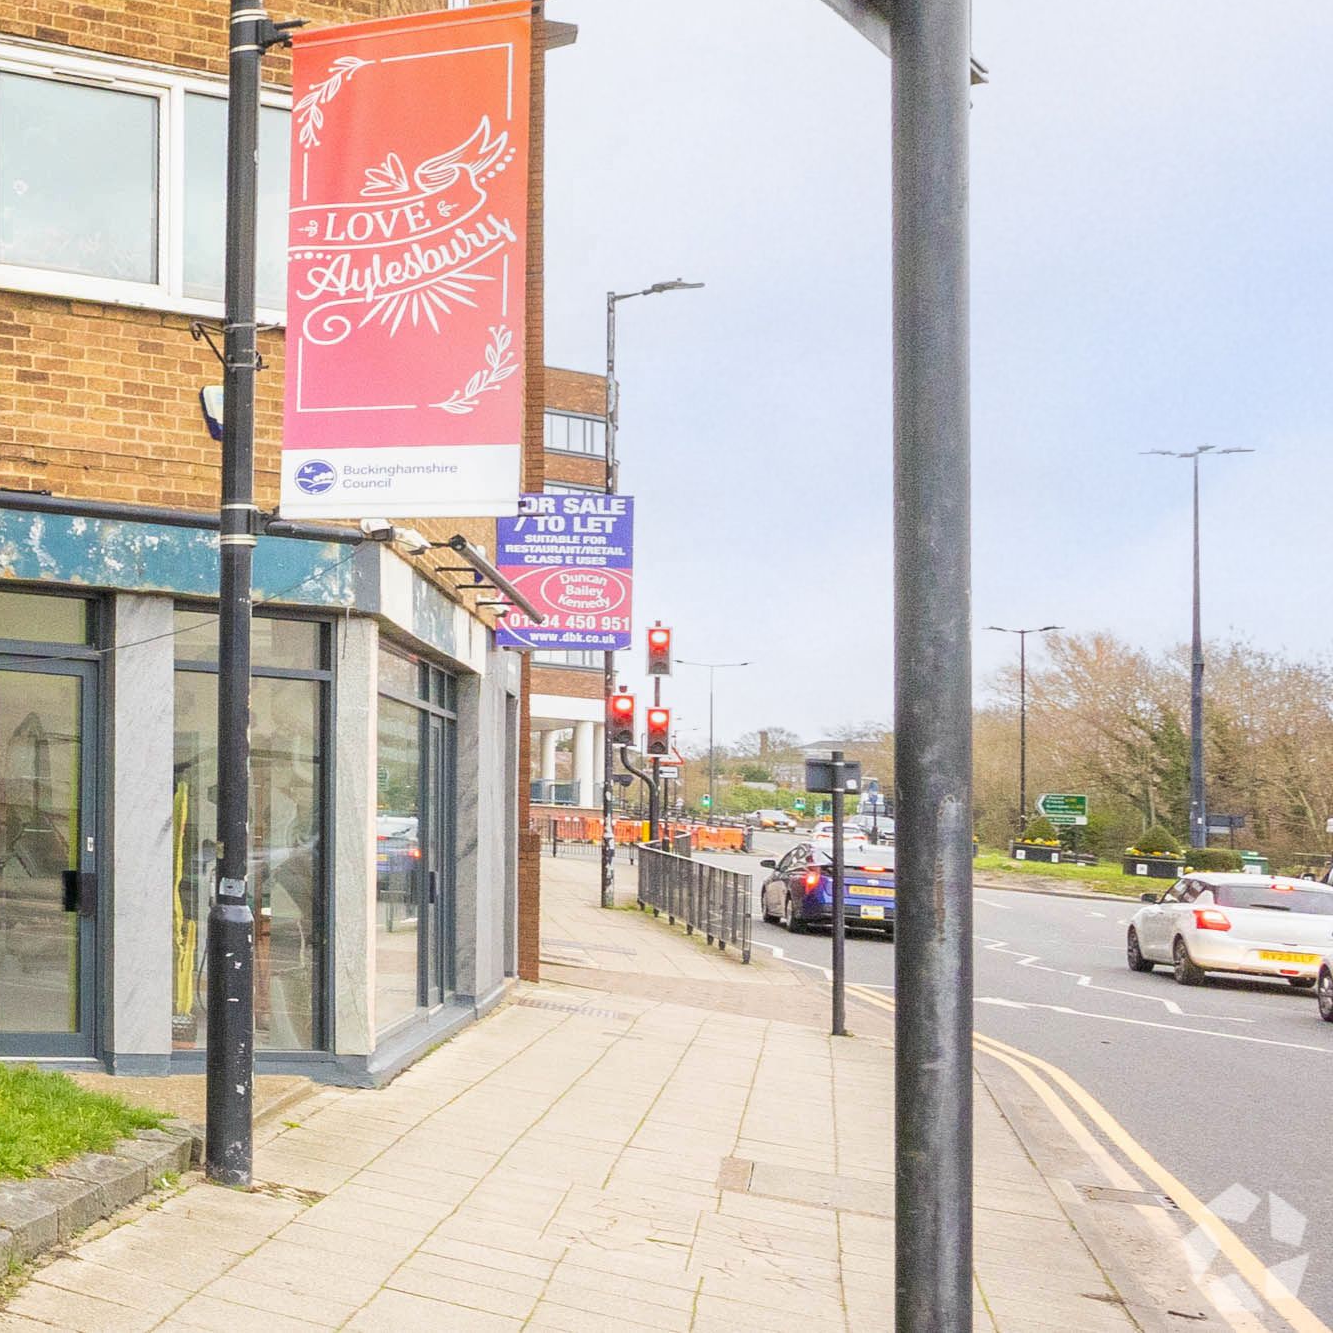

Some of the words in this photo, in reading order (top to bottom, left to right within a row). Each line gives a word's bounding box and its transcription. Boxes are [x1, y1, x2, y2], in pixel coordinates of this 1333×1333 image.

[323, 201, 432, 242] LOVE
[296, 214, 517, 302] Aylesbury
[342, 462, 459, 477] Buckinghamshire
[342, 477, 392, 490] Council
[521, 497, 555, 514] OR
[563, 497, 626, 515] SALE
[533, 516, 565, 533] TO
[573, 517, 617, 533] LET
[524, 534, 581, 544] SUITABLE
[583, 535, 607, 544] FOR
[505, 544, 626, 556] RESTAURANT/RETAIL
[524, 554, 563, 564] CLASS
[565, 555, 573, 564] E
[576, 556, 607, 565] USES
[559, 573, 608, 587] Duncan
[565, 585, 604, 599] Bailey
[557, 594, 610, 609] Kennedy
[565, 615, 596, 630] 450
[601, 617, 630, 631] 951
[529, 632, 616, 644] www.dbk.co.uk
